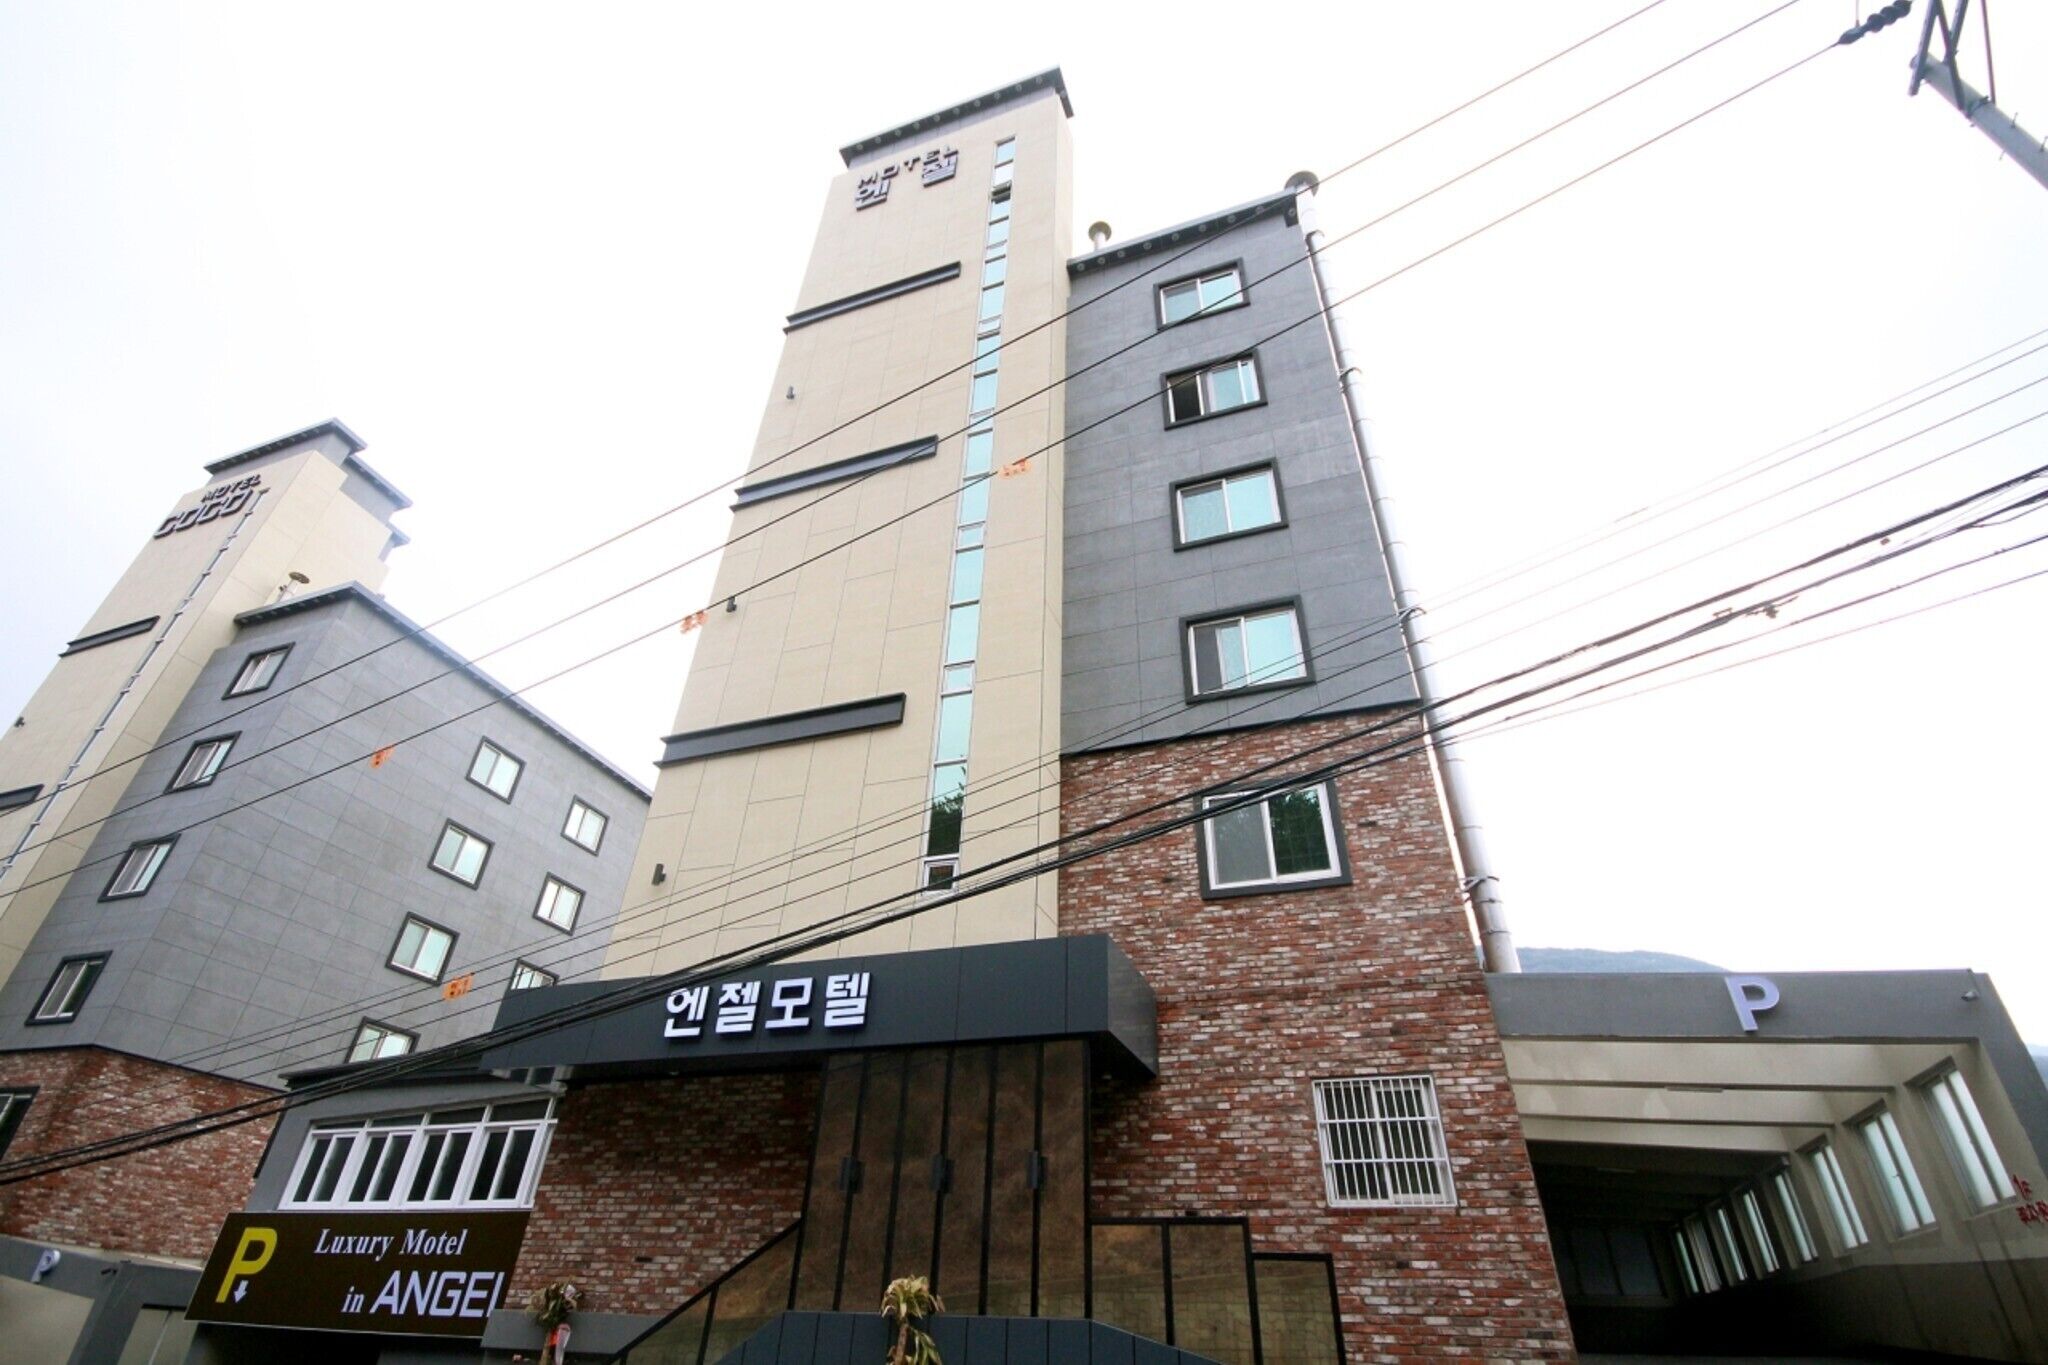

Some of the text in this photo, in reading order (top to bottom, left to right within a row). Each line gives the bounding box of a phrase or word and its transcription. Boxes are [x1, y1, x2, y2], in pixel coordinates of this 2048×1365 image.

[858, 145, 959, 189] MOTEL
[200, 474, 261, 502] MOTEL
[664, 972, 870, 1038] 엔젤모텔
[1724, 975, 1780, 1032] P
[215, 1227, 278, 1303] P
[314, 1228, 469, 1262] Luxury Motel
[340, 1286, 365, 1314] in
